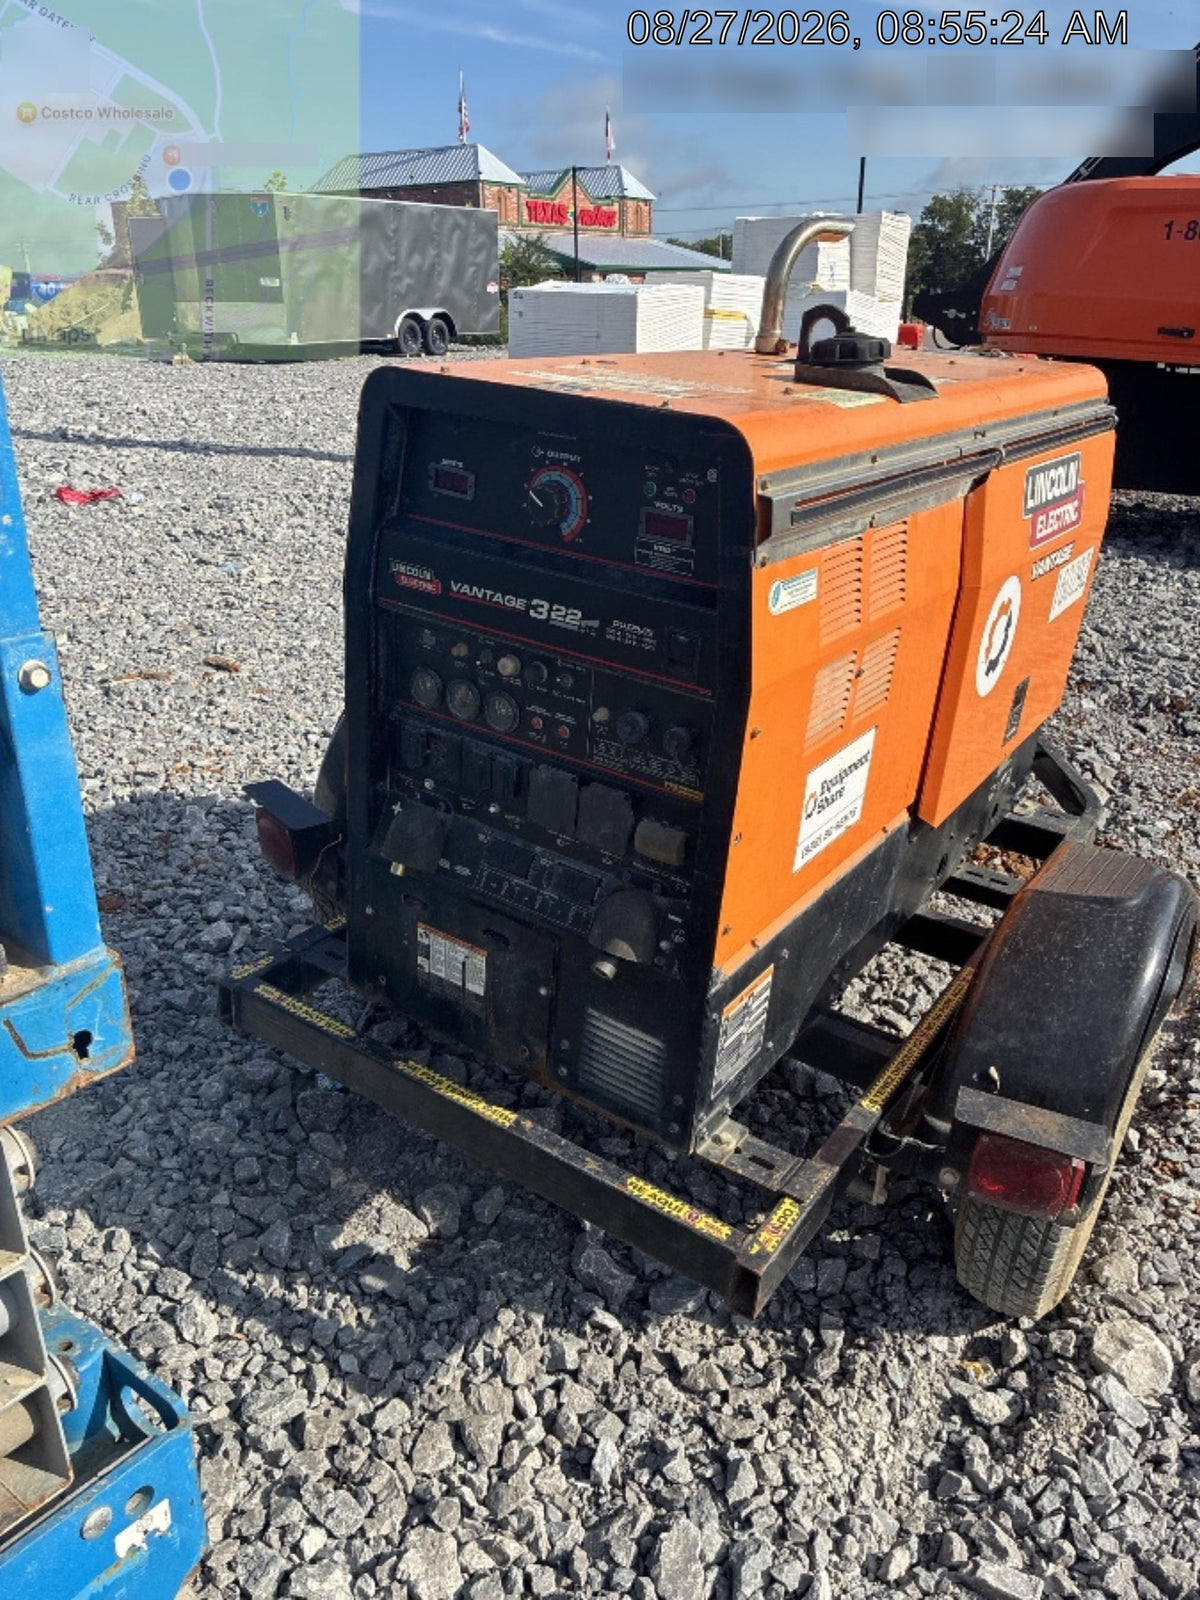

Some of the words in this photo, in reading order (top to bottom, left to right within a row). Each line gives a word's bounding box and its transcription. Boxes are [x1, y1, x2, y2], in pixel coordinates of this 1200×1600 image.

[526, 200, 568, 226] TEXAS
[1164, 219, 1200, 241] 1-8
[1027, 459, 1080, 510] LINCOLN
[1035, 499, 1080, 541] ELECTRIC
[450, 580, 527, 611] VANTAGE
[528, 598, 583, 626] 322
